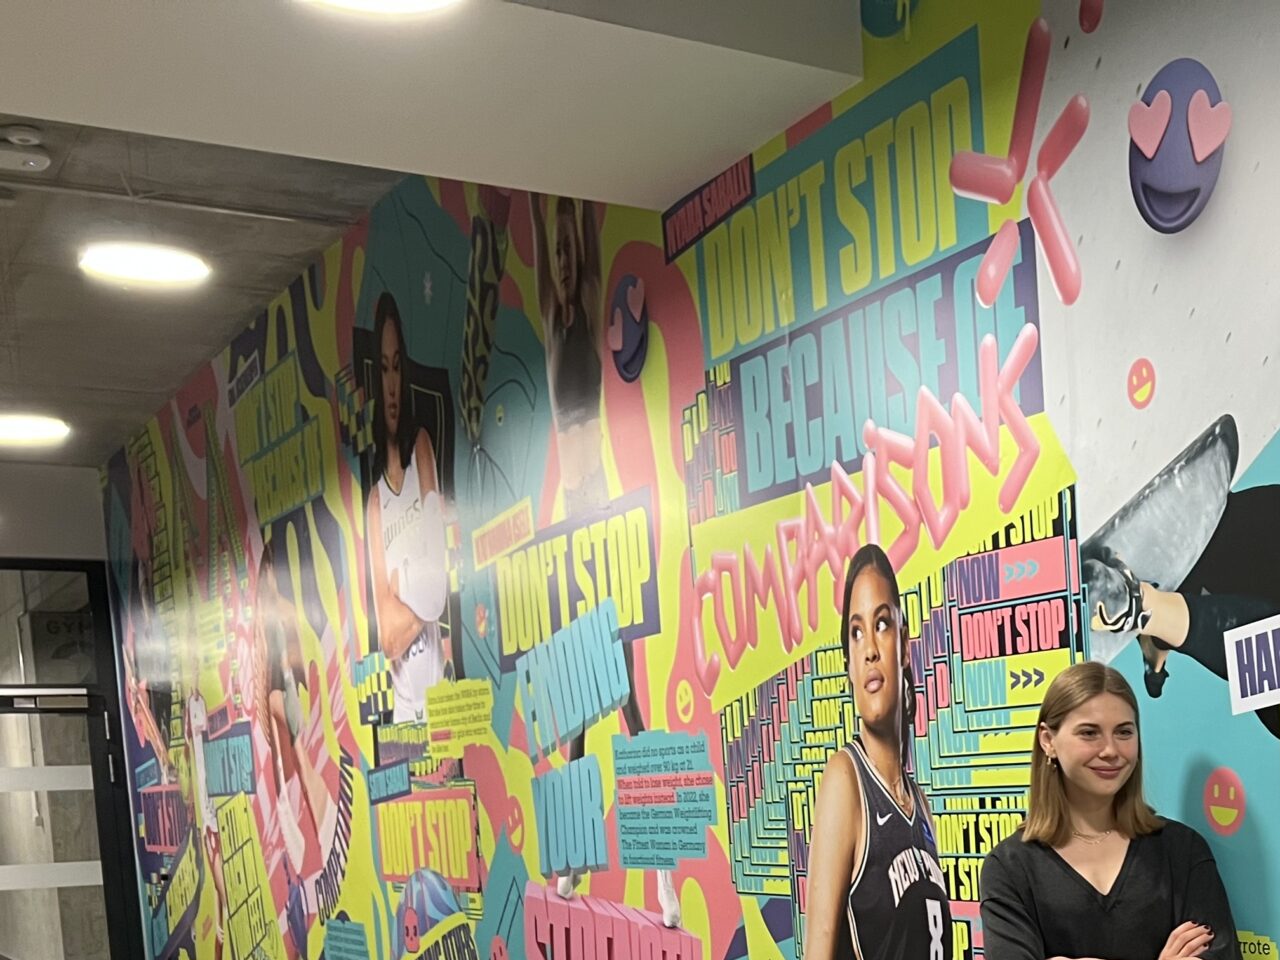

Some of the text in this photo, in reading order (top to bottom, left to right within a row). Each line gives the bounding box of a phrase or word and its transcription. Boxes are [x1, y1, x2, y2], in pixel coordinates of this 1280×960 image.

[704, 77, 973, 358] DON'T STOP
[740, 274, 942, 487] BECAUSE
[497, 536, 570, 656] DON'T
[572, 506, 650, 630] STOP
[958, 552, 1000, 608] NOW
[960, 598, 1065, 661] DON'T STOP
[516, 596, 630, 764] FINDING
[964, 659, 1007, 711] NOW
[690, 741, 705, 754] child
[380, 798, 471, 881] DON'T STOP
[531, 754, 608, 879] YOUR
[933, 813, 976, 855] DON'T
[888, 848, 919, 908] NEW
